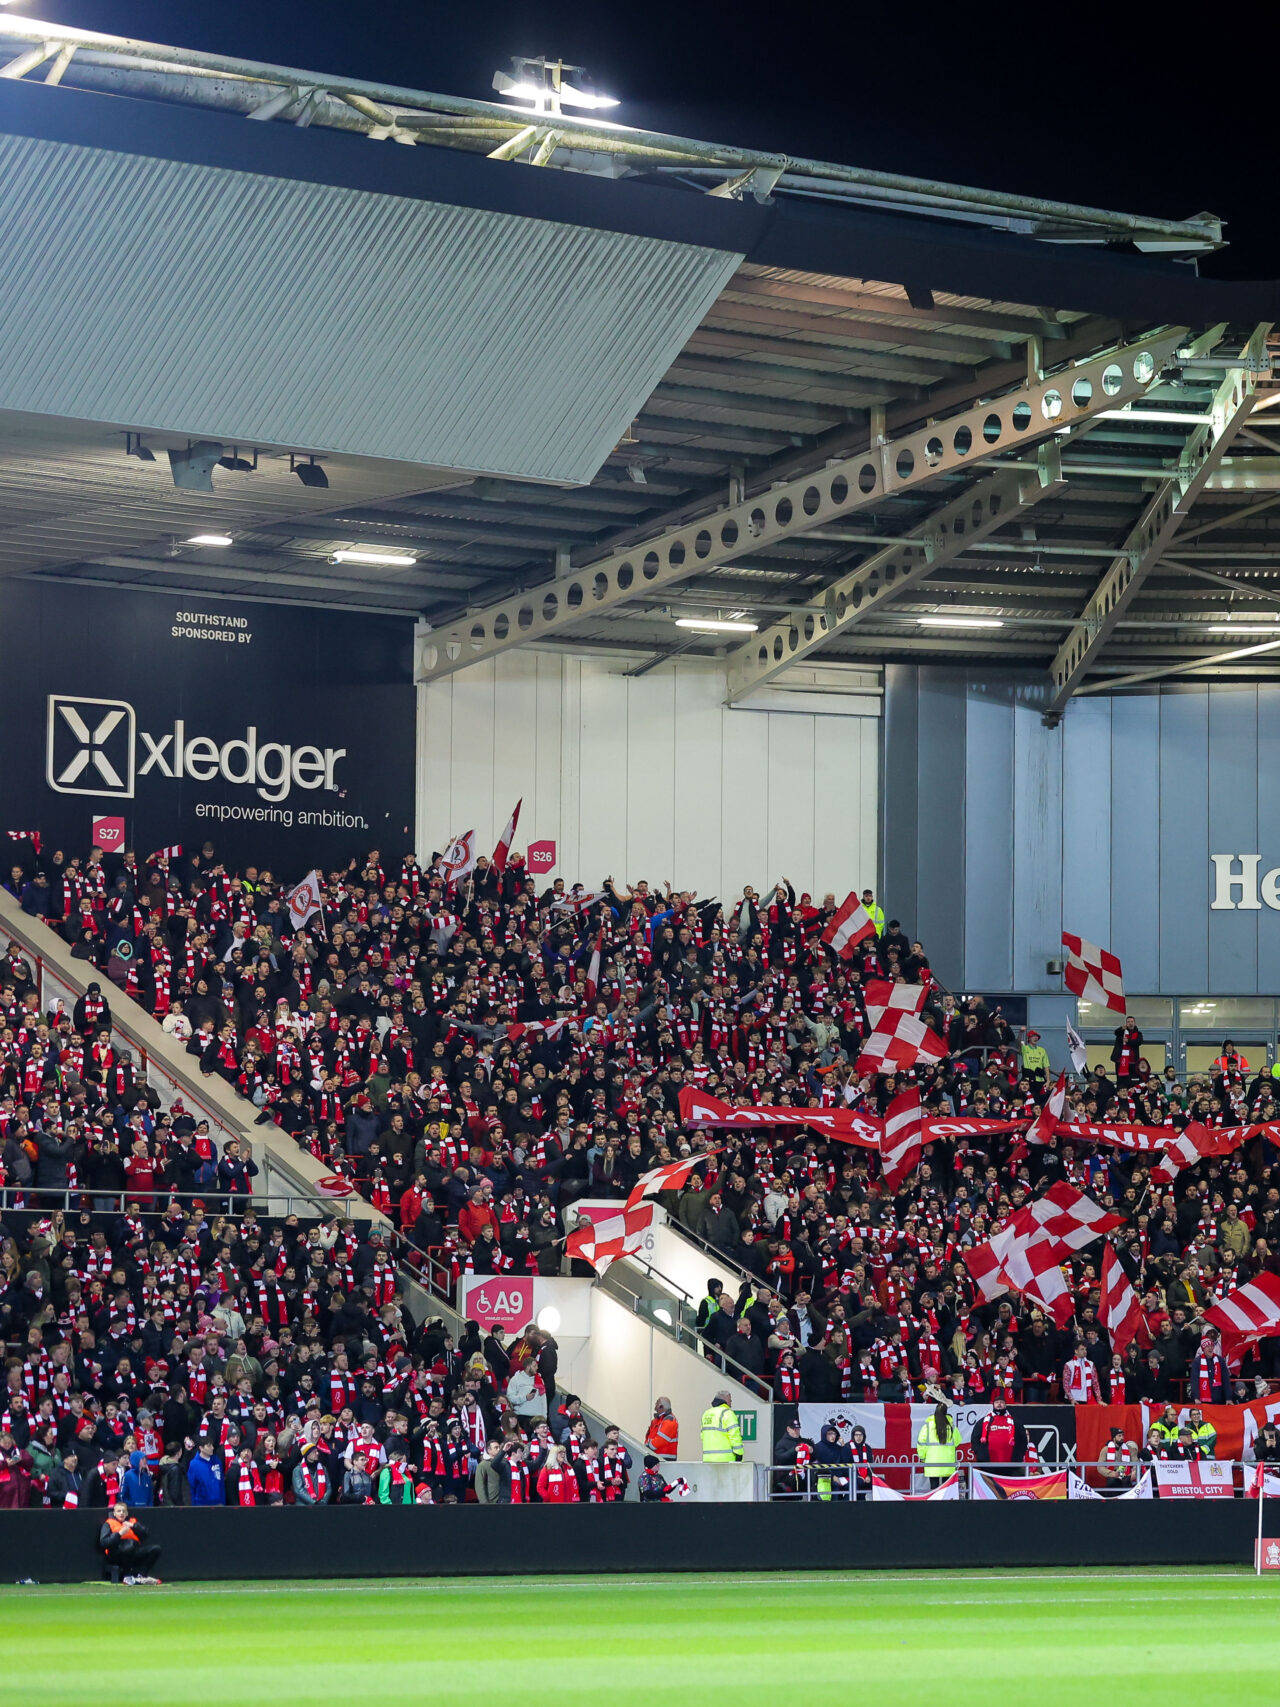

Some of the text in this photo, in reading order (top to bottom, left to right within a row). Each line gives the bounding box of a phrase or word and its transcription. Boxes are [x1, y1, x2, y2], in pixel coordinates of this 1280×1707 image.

[171, 626, 252, 643] SPONSORED BY
[137, 720, 346, 802] xledger
[195, 802, 293, 826] empowering
[98, 828, 120, 840] S27
[533, 851, 553, 862] S26
[493, 1290, 524, 1315] A9
[1171, 1486, 1224, 1495] BRISTOL CITY
